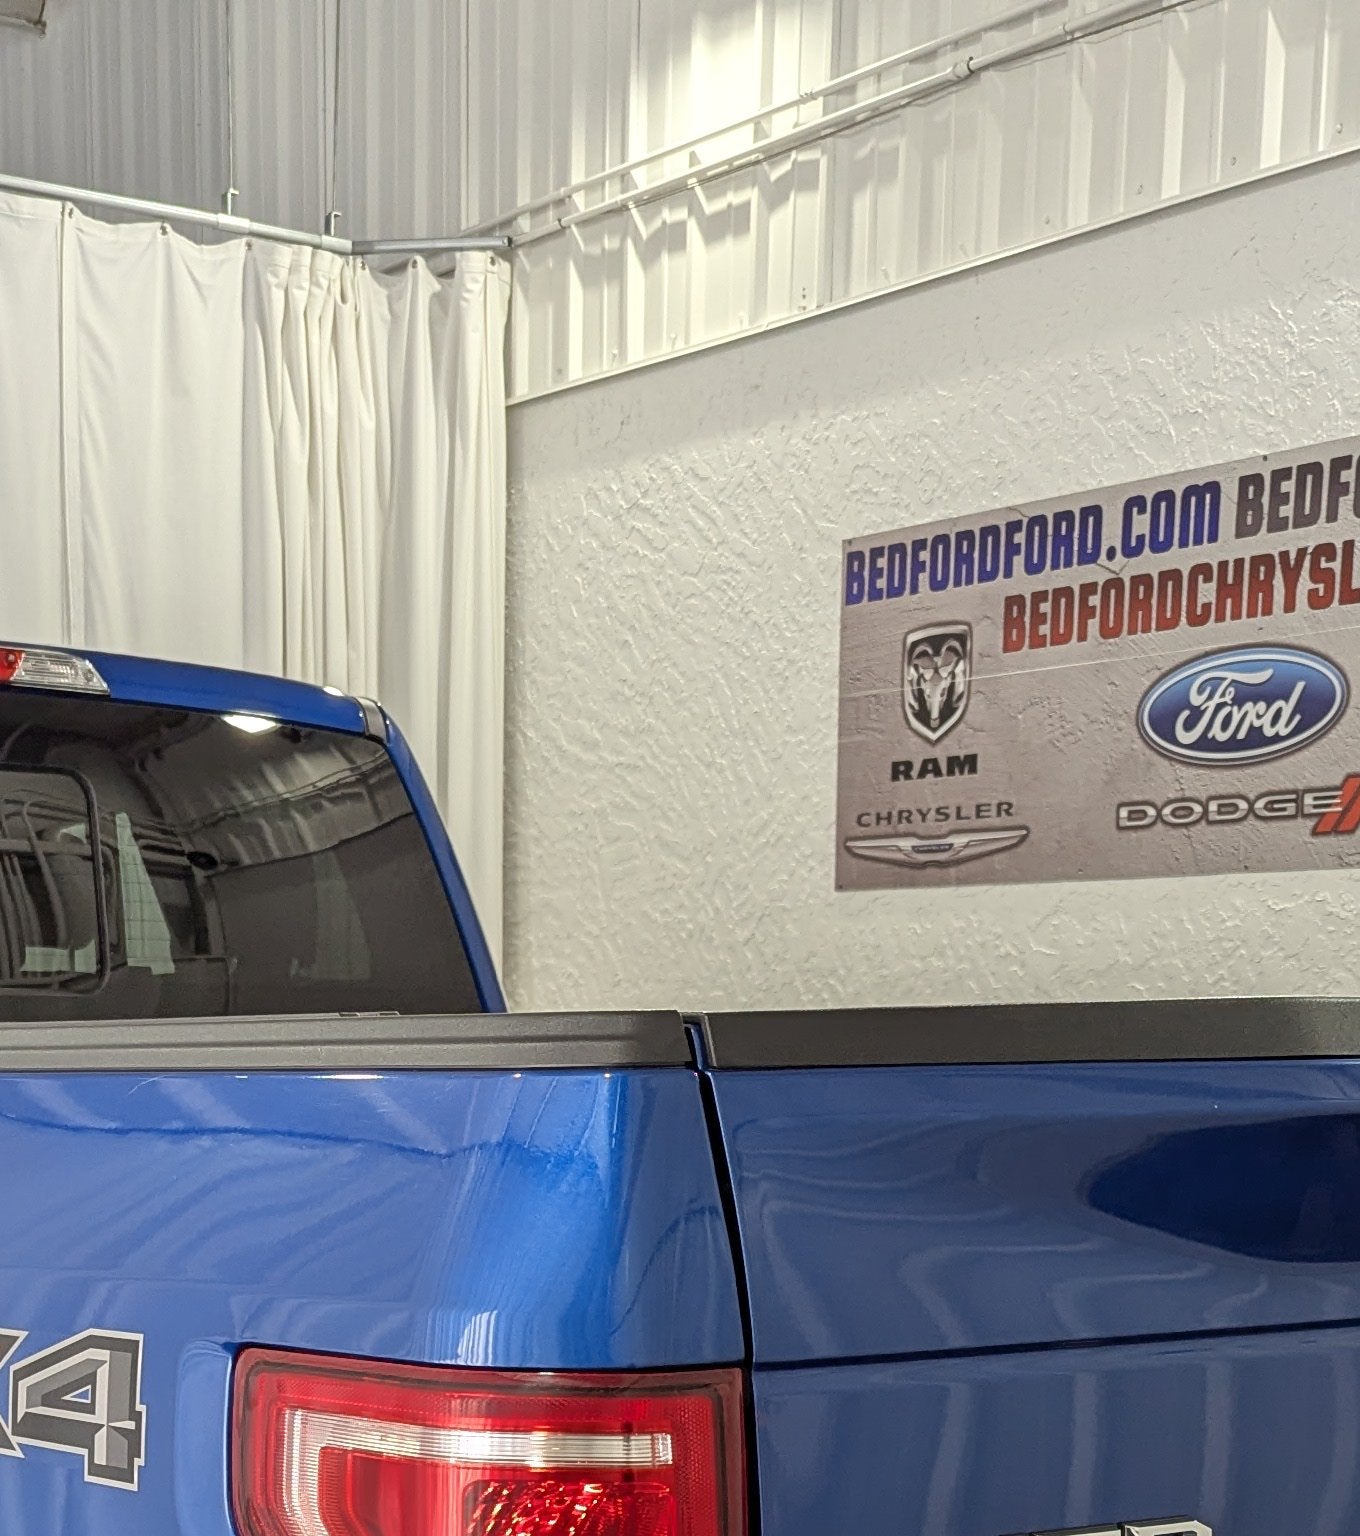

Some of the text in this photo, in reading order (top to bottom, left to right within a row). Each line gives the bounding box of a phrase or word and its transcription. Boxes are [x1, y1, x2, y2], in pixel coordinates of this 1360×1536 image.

[844, 479, 1222, 607] BEDFORDFORD.COM
[1174, 668, 1307, 745] Ford
[890, 753, 979, 783] RAM
[855, 801, 1015, 828] CHRYSLER
[1116, 785, 1344, 831] DODGE
